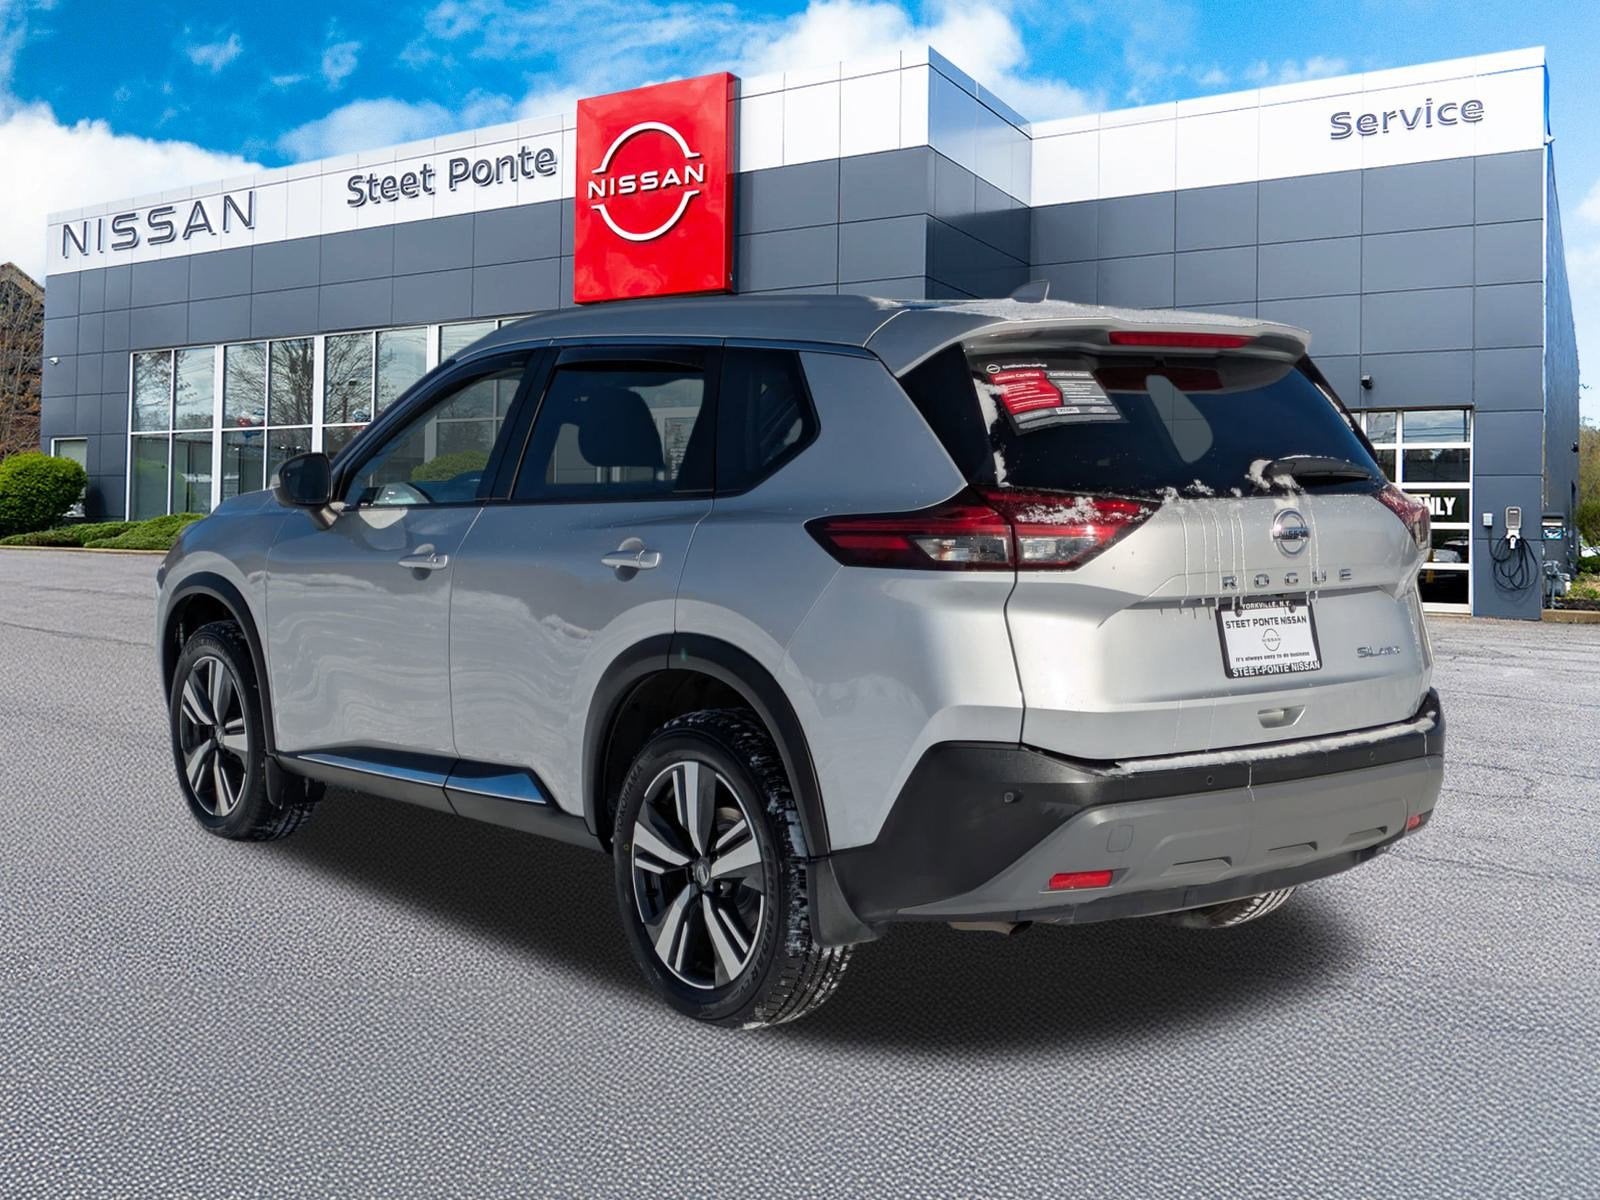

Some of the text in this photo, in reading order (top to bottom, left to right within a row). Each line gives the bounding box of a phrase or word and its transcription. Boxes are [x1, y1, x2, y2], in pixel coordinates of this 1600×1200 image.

[1330, 98, 1484, 140] Service
[347, 146, 557, 207] Steet Ponte
[587, 163, 705, 199] NISSAN
[62, 191, 255, 259] NISSAN
[1423, 497, 1456, 516] NLY
[1222, 569, 1352, 589] ROGUE
[1225, 616, 1307, 629] STEET PONTE NISSAN
[1232, 660, 1320, 677] STEET-PONTE NISSAN
[616, 763, 643, 832] YOKOHAMA
